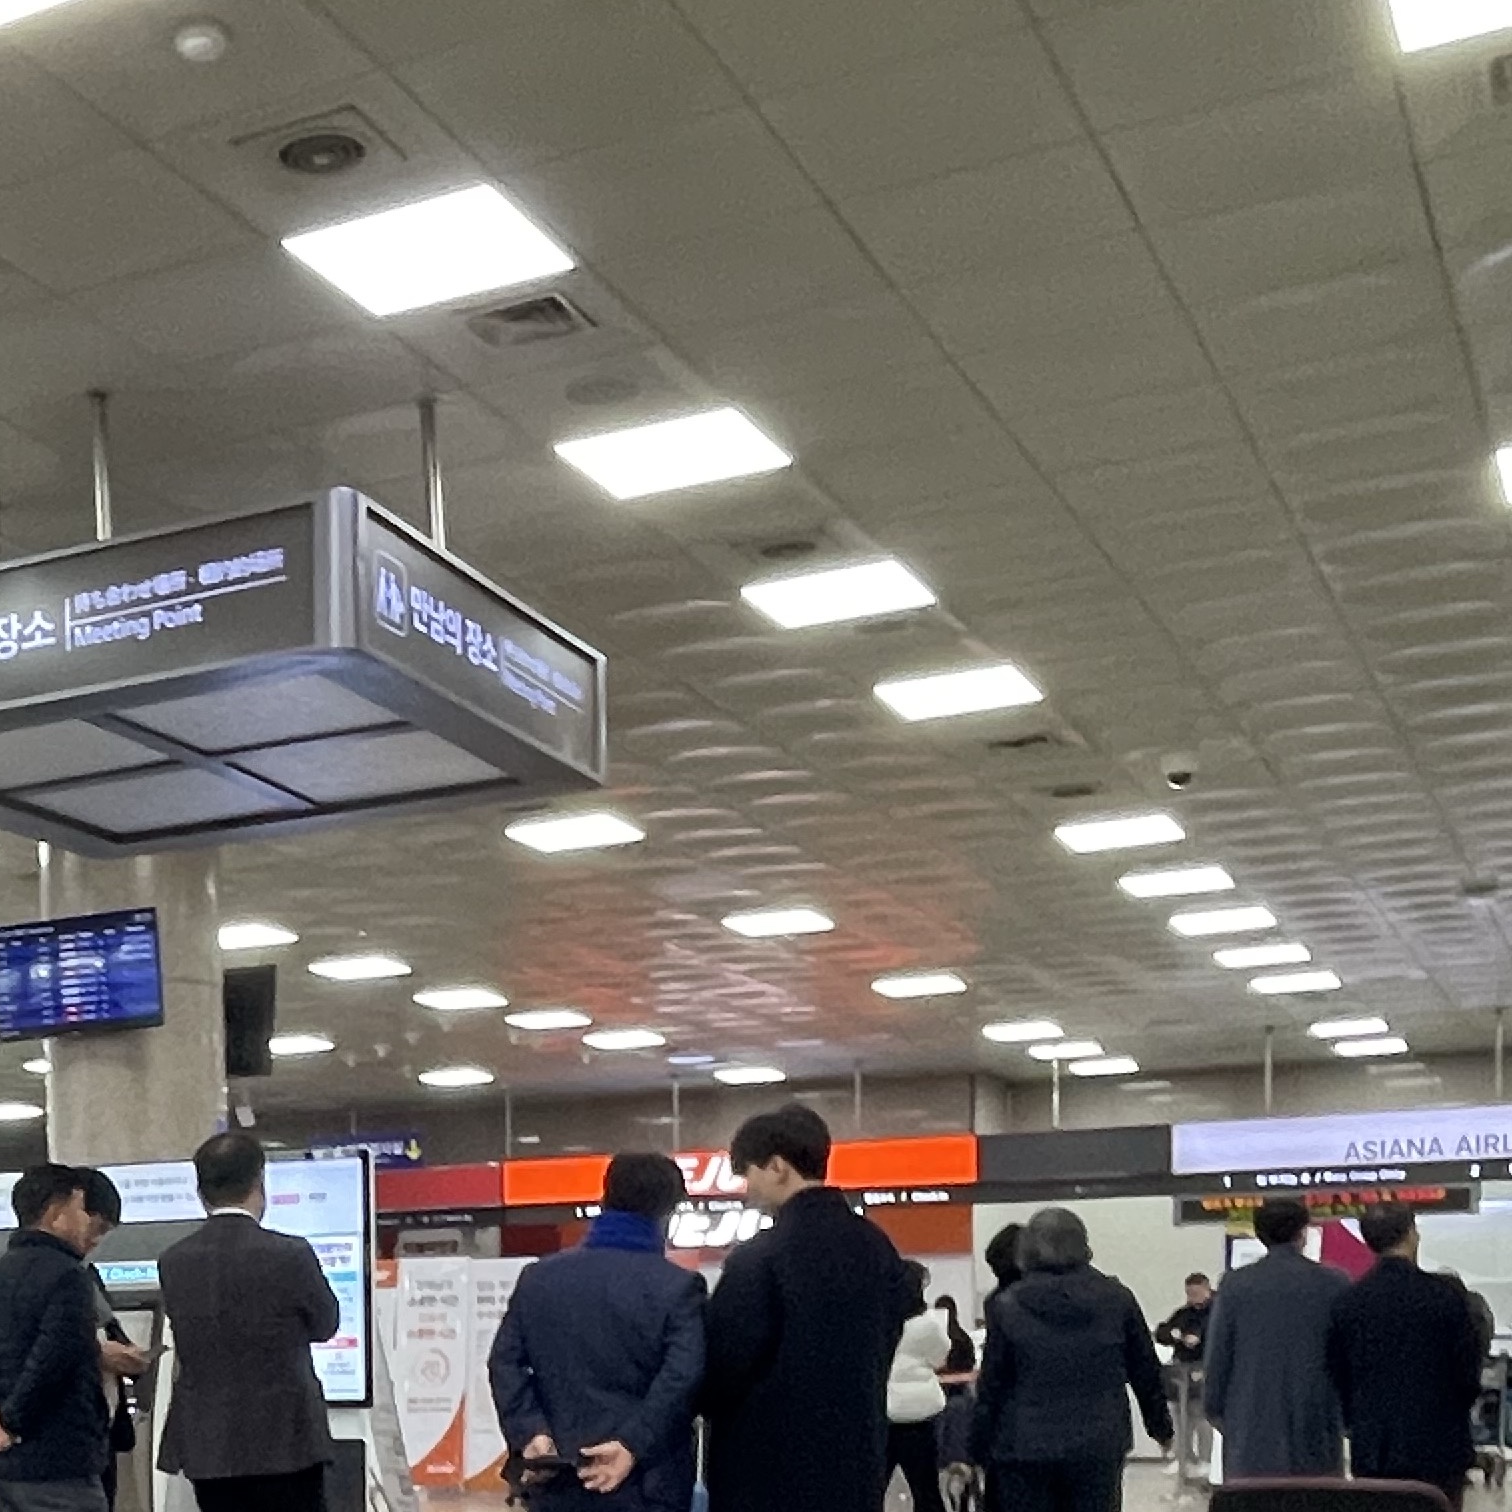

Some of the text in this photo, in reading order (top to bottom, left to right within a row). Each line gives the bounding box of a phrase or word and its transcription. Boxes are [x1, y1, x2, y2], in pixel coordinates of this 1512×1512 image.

[74, 603, 204, 648] Meeting Point
[409, 585, 463, 655] 만남의
[1344, 1137, 1445, 1163] ASIANA
